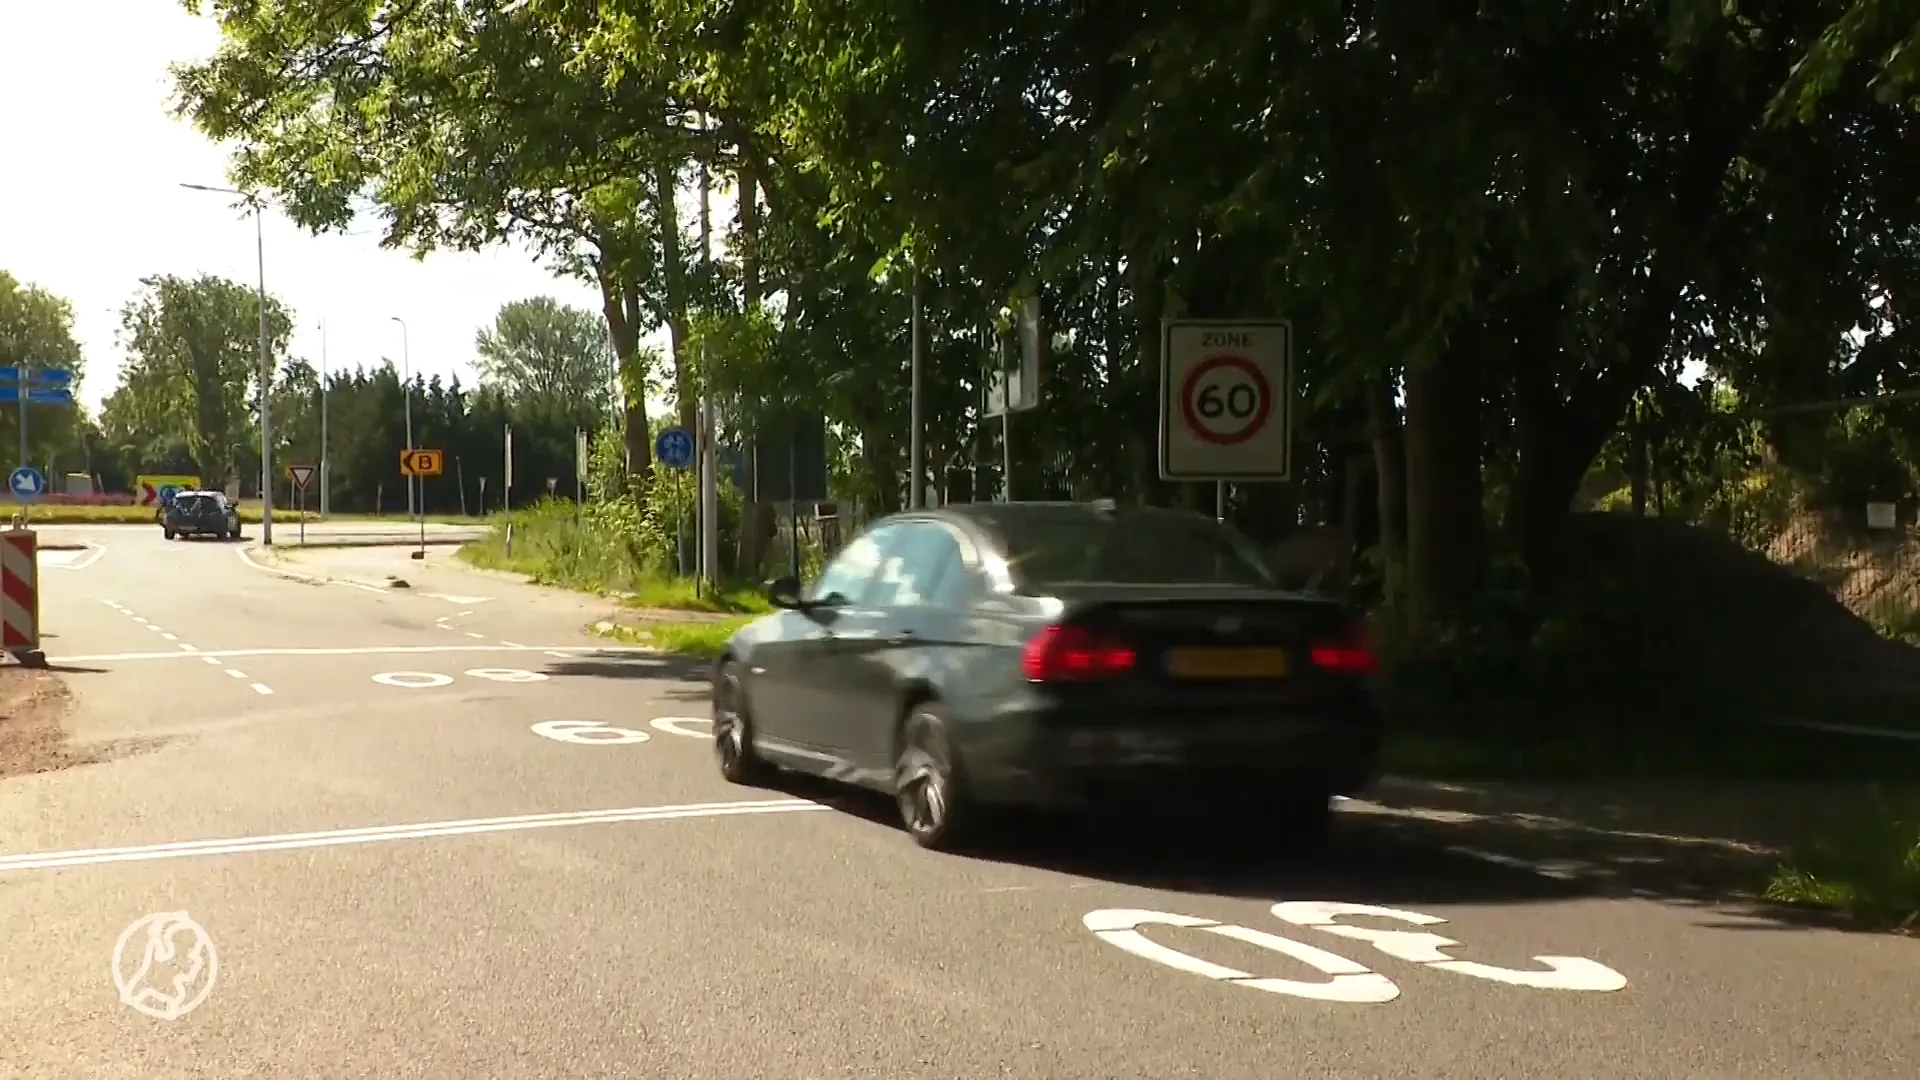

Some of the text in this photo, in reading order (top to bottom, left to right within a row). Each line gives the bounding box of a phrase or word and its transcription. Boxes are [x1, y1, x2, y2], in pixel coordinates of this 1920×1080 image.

[1201, 332, 1256, 348] ZONE
[1197, 383, 1256, 419] 60
[418, 454, 433, 470] B
